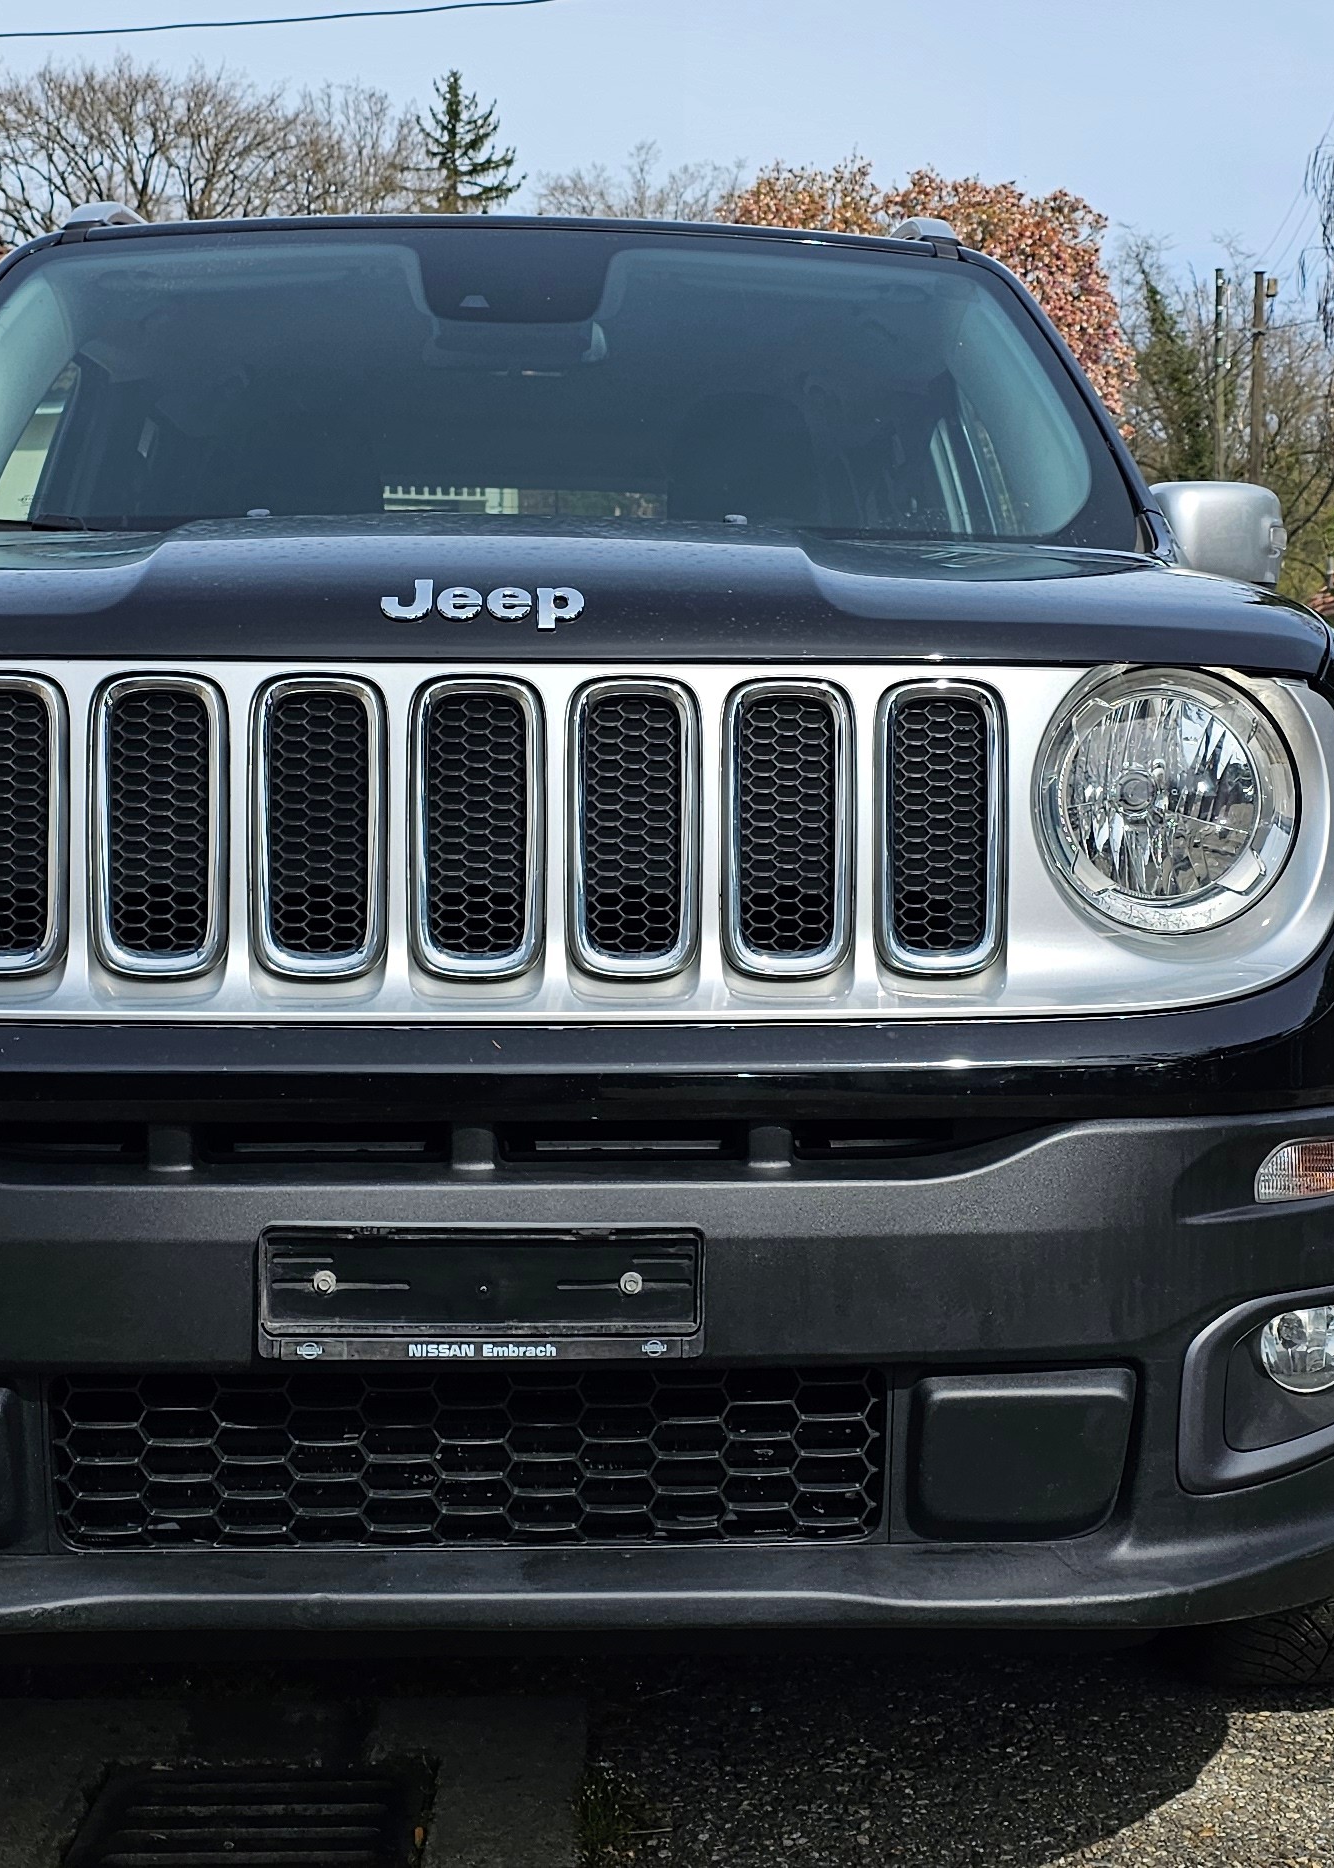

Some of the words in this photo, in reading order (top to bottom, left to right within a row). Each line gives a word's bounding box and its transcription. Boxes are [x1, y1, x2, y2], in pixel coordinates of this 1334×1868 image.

[380, 579, 585, 632] Jeep
[408, 1344, 475, 1357] NISSAN
[482, 1344, 557, 1357] Embrach
